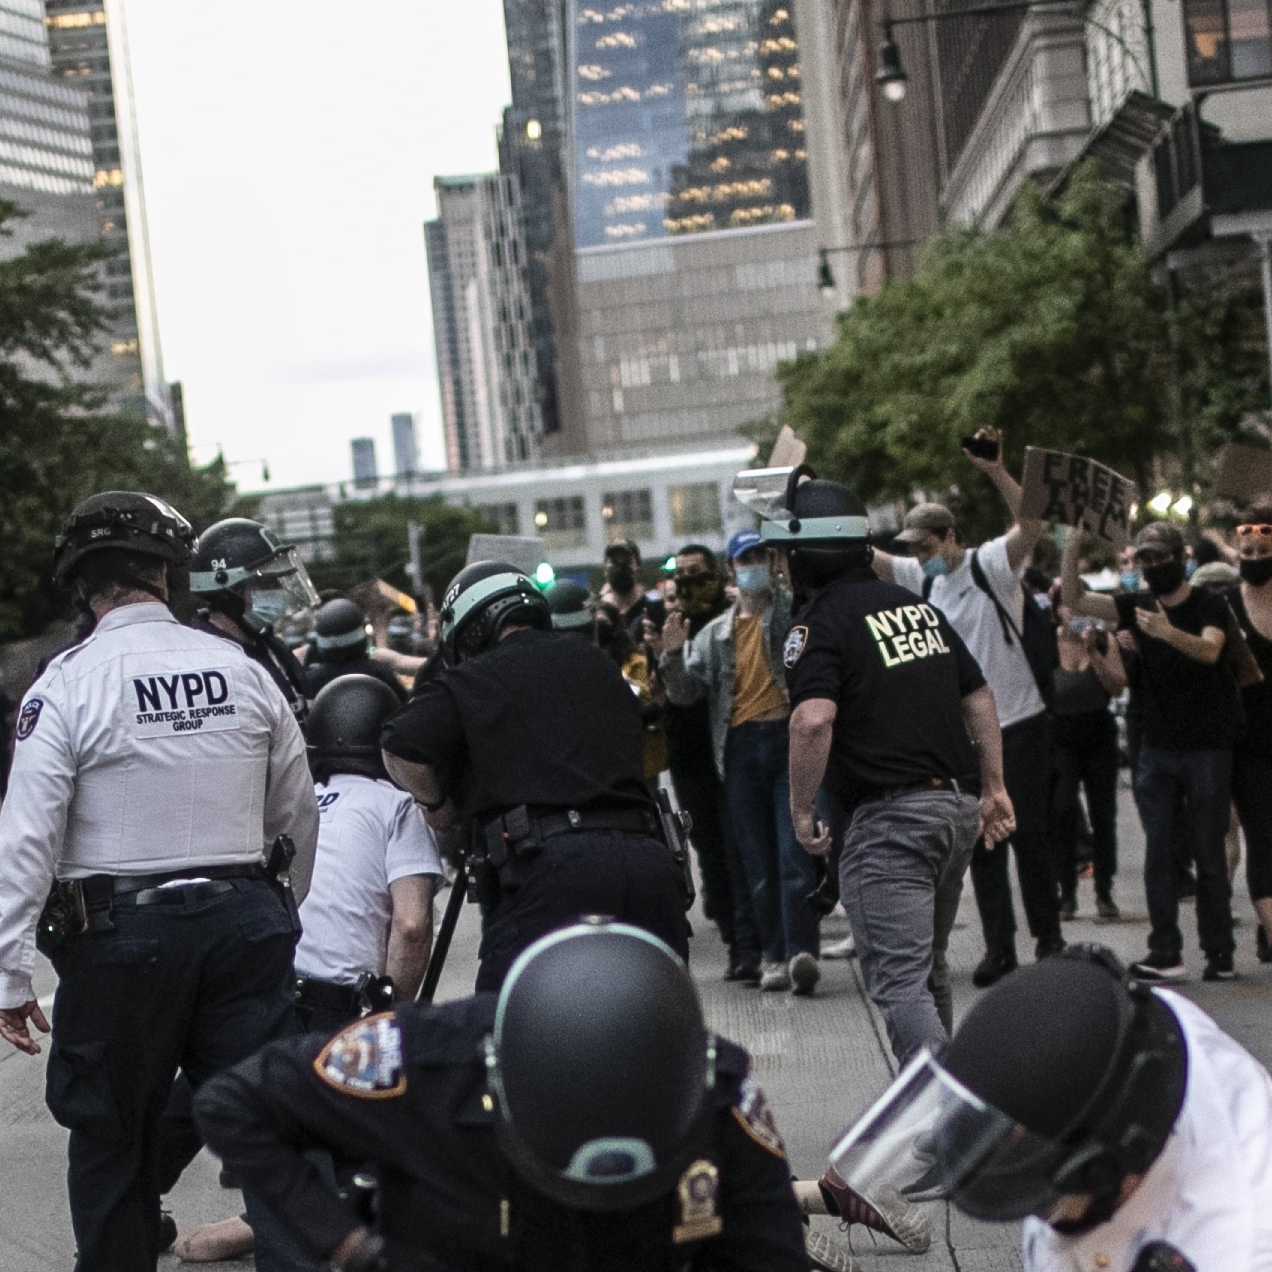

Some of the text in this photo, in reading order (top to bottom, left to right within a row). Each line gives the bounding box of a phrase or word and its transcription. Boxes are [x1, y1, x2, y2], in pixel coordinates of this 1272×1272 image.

[1043, 453, 1124, 502] FREE
[1047, 477, 1127, 530] THEM
[90, 527, 112, 539] SRG
[865, 603, 939, 640] NYPD
[878, 628, 950, 667] LEGAL
[133, 670, 229, 712] NYPD
[136, 705, 236, 724] STRATEGIC RESPONSE
[172, 718, 203, 732] GROUP
